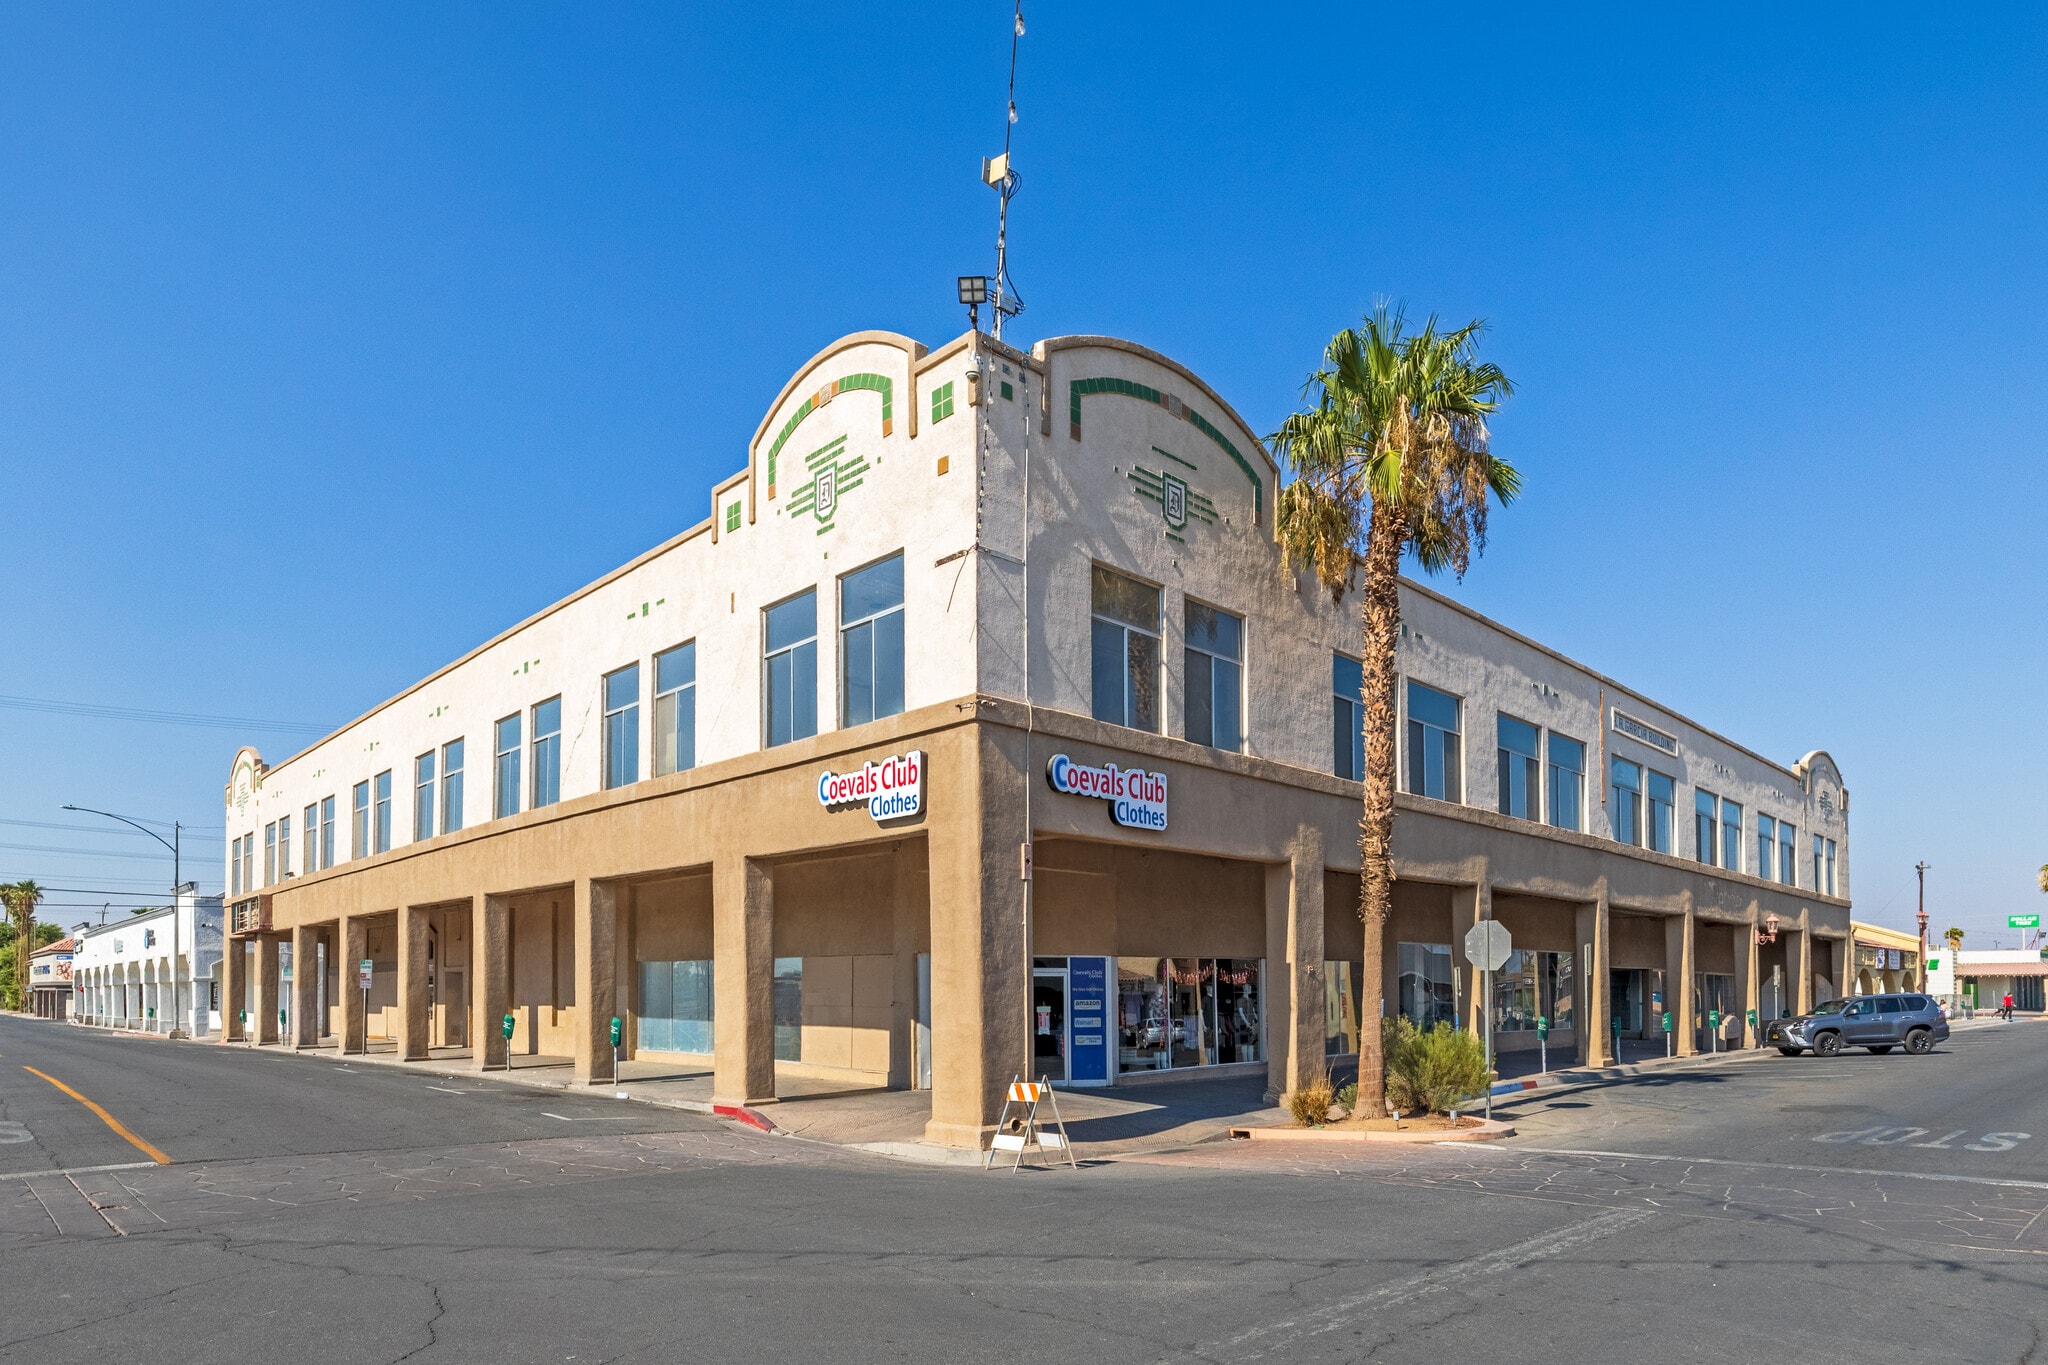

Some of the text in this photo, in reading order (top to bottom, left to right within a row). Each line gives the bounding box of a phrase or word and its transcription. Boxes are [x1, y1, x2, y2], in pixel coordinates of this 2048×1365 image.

[1649, 731, 1674, 752] BUILDING
[820, 757, 918, 801] Coevals Club
[1054, 757, 1165, 803] Coevals Club
[871, 792, 918, 817] Clothes
[1117, 801, 1165, 827] Clothes
[1811, 1125, 2033, 1152] STOP
